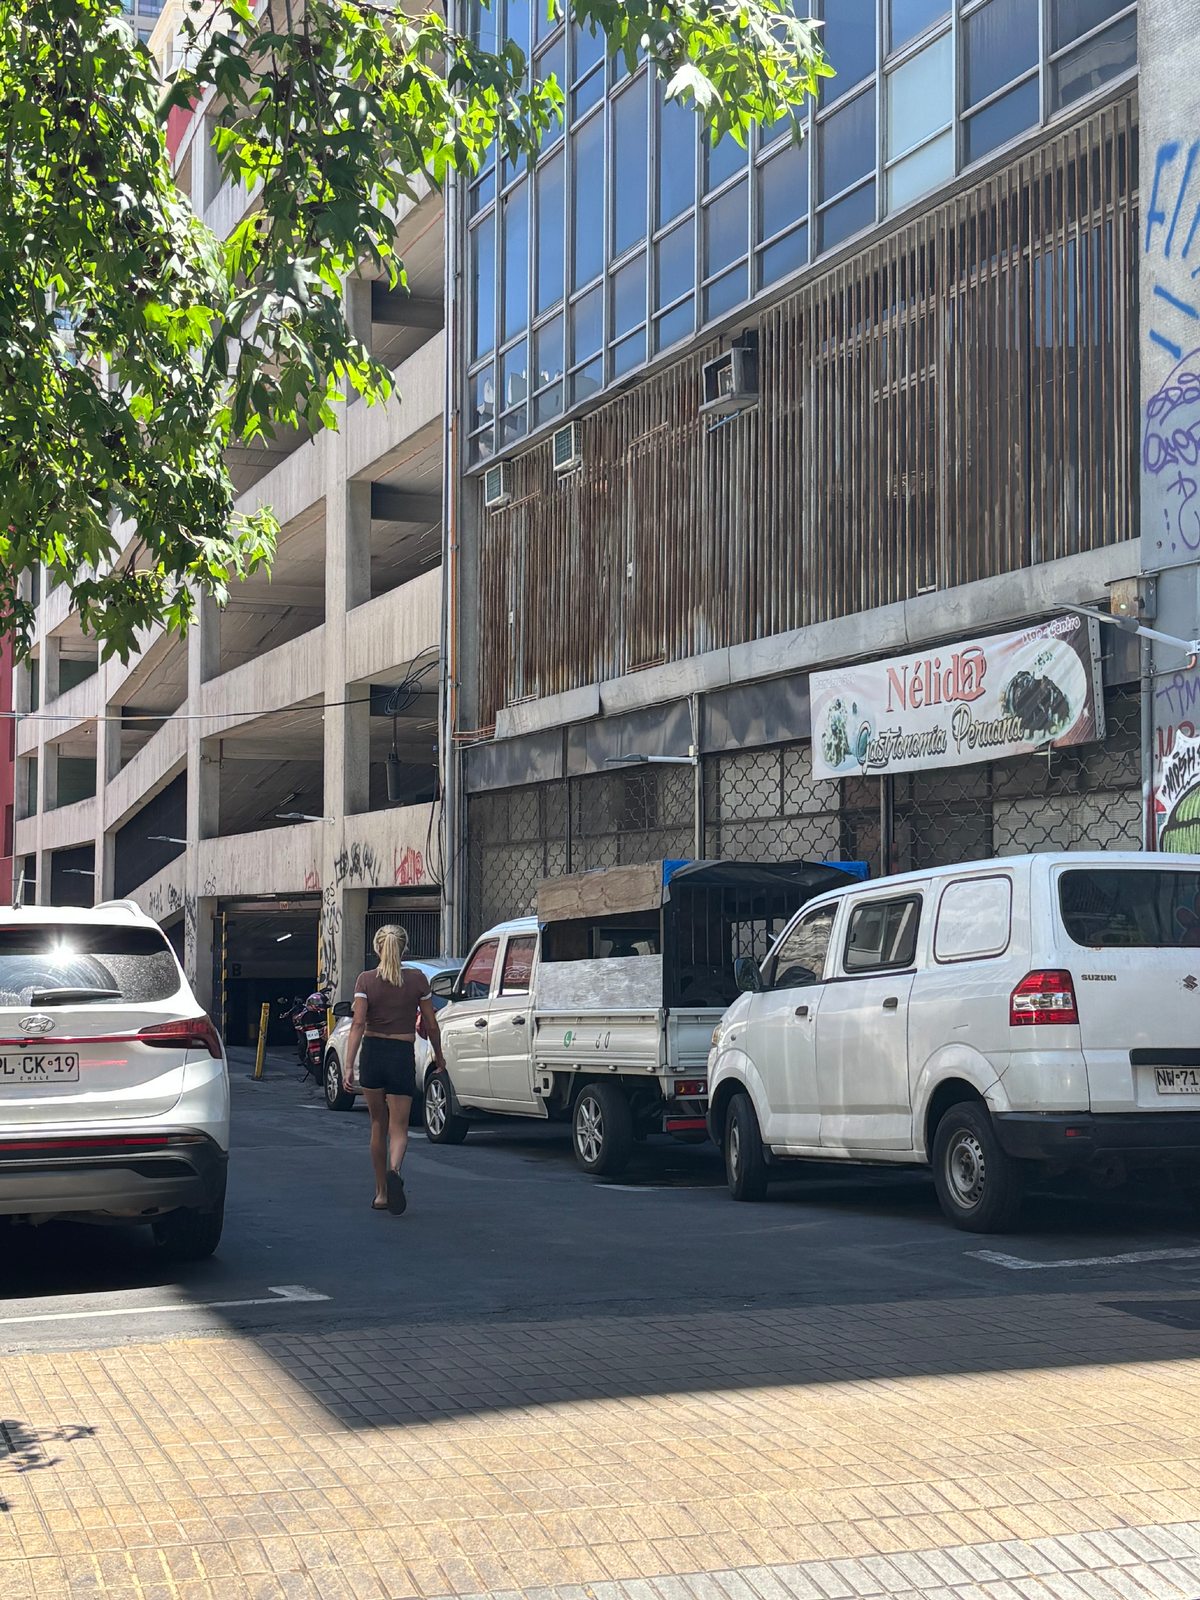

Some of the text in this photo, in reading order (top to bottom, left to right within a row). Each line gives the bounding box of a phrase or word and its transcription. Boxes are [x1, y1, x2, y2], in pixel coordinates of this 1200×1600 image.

[1049, 615, 1081, 637] Centro
[886, 646, 987, 713] Nélida
[857, 702, 1024, 775] Gastronomía Peruana
[1081, 974, 1117, 982] SUZUKI
